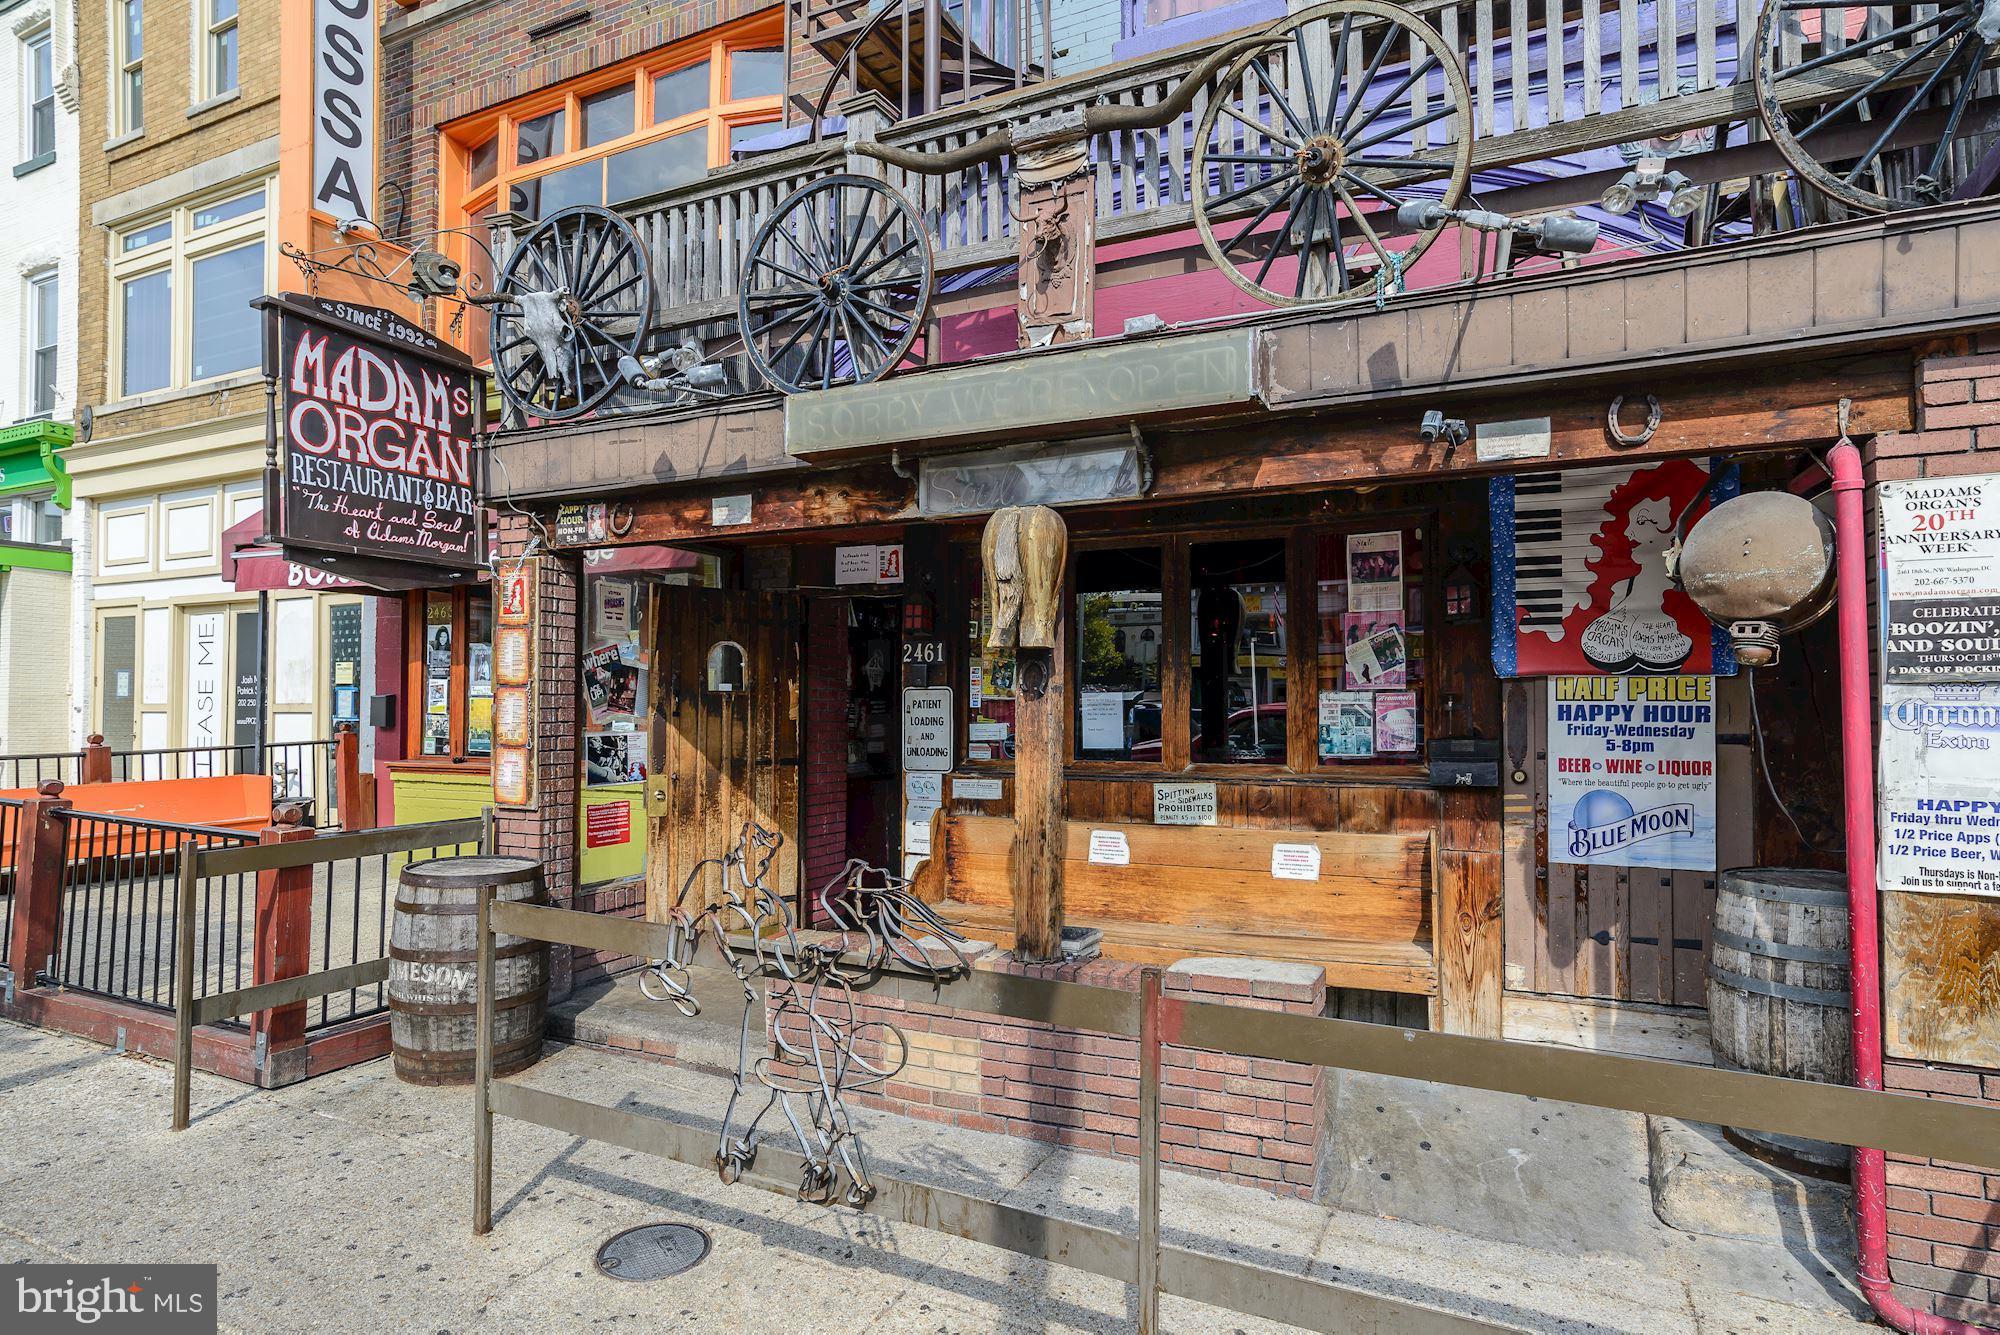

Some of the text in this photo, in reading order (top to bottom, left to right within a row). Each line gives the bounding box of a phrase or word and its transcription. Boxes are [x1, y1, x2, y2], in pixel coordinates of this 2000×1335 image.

[334, 303, 425, 348] SINCE 1992
[1107, 351, 1231, 401] OPEN
[289, 399, 472, 486] ORGAN
[1904, 485, 1982, 501] MADAMS
[1905, 497, 1982, 512] ORGAN'S
[332, 495, 386, 522] Heart
[389, 511, 419, 528] and
[422, 511, 463, 534] Soul
[560, 515, 584, 525] HOUR
[1911, 508, 1976, 532] 20TH
[343, 520, 361, 540] of
[367, 521, 415, 546] Adams
[1918, 542, 1970, 554] WEEK
[1914, 576, 1975, 586] 202-667-5370
[1655, 620, 1675, 630] HEART
[1586, 631, 1625, 649] ORGAN
[1632, 630, 1655, 644] ADAMS
[902, 643, 944, 663] 2461
[1887, 639, 1934, 653] AND
[583, 648, 619, 671] where
[1918, 654, 1955, 663] THURS
[1956, 653, 1980, 662] OCT
[1888, 664, 2000, 674] 4 DAYS OF ROCKIN
[1555, 676, 1712, 702] HALF PRICE
[196, 616, 215, 778] LEASE ME.
[912, 699, 942, 709] PATIENT
[910, 716, 944, 726] LOADING
[1557, 704, 1711, 723] HAPPY HOUR
[920, 732, 935, 741] AND
[1567, 723, 1696, 740] Friday-Wednesday
[1605, 738, 1655, 754] 5-8pm
[1926, 729, 1990, 750] Extra
[906, 747, 949, 757] UNLOADING
[1558, 757, 1712, 778] BEER WINE LIQUOR
[1584, 778, 1596, 787] the
[1597, 778, 1630, 787] beautiful
[1631, 780, 1655, 792] people
[1677, 781, 1690, 790] get
[1157, 788, 1195, 801] SPITTING
[1177, 792, 1213, 804] SIDEWALKS
[1158, 803, 1213, 812] PROHIBITED
[1890, 812, 1930, 826] Friday
[1934, 814, 1962, 826] thru
[1569, 808, 1689, 858] BLUE MOON
[1894, 828, 1915, 840] 1/2
[1919, 829, 1953, 842] Price
[1956, 831, 1991, 845] Apps
[1888, 844, 1909, 856] 1/2
[1913, 845, 1947, 858] Price
[1951, 847, 1985, 862] Beer,
[1919, 866, 2000, 881] Thursdays is Non-
[1901, 876, 1920, 886] Join
[1922, 879, 1933, 887] us
[1935, 879, 1944, 887] to
[1983, 883, 1990, 891] a
